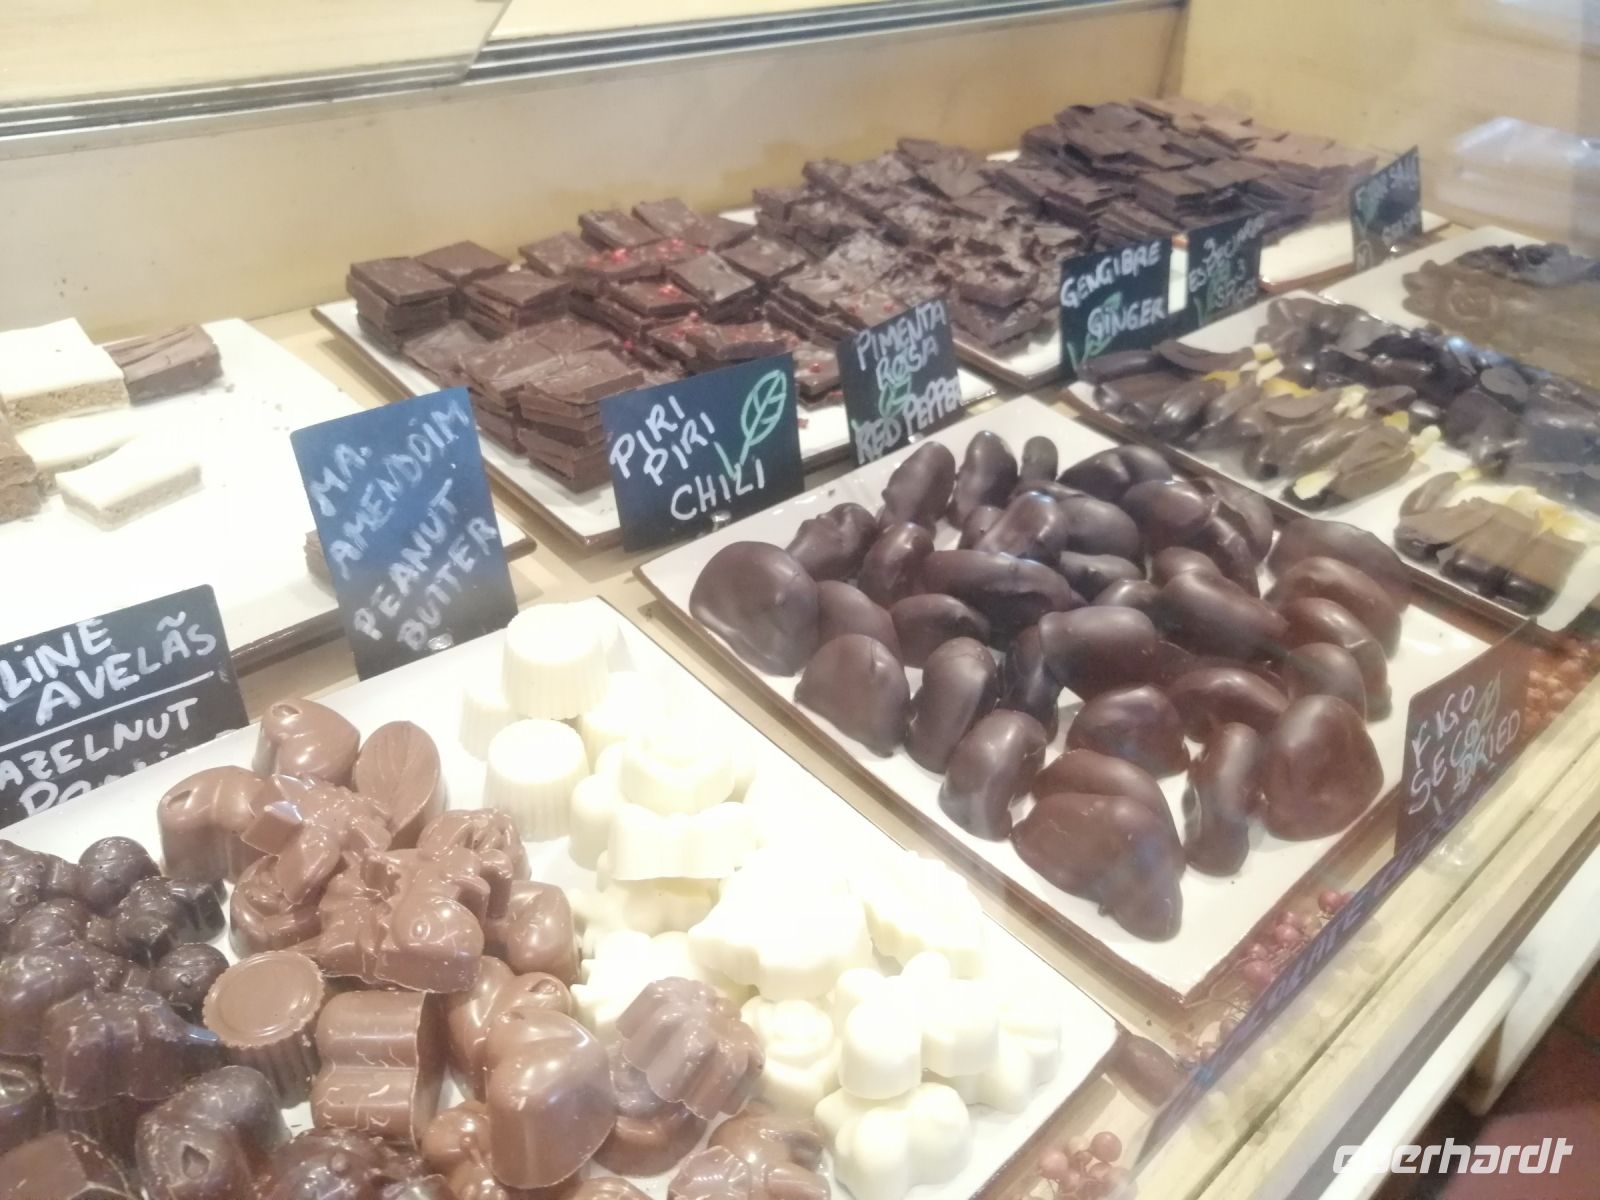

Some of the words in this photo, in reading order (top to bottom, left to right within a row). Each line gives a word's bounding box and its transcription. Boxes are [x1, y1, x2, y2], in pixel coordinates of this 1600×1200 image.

[1060, 241, 1161, 308] GENGIBRE
[855, 299, 946, 371] PIMENTA
[1087, 297, 1166, 337] GINGER
[875, 336, 938, 390] ROSA
[609, 395, 686, 479] PIRI
[643, 412, 716, 486] PIRI
[329, 399, 470, 581] AMENDOIM
[670, 458, 765, 521] CHILI
[353, 477, 459, 642] PEANUT
[396, 516, 499, 651] BUTTER
[0, 617, 113, 712] LINE
[35, 611, 217, 726] AVELÃS
[1407, 717, 1481, 816] SECO
[1411, 684, 1476, 769] FIGO
